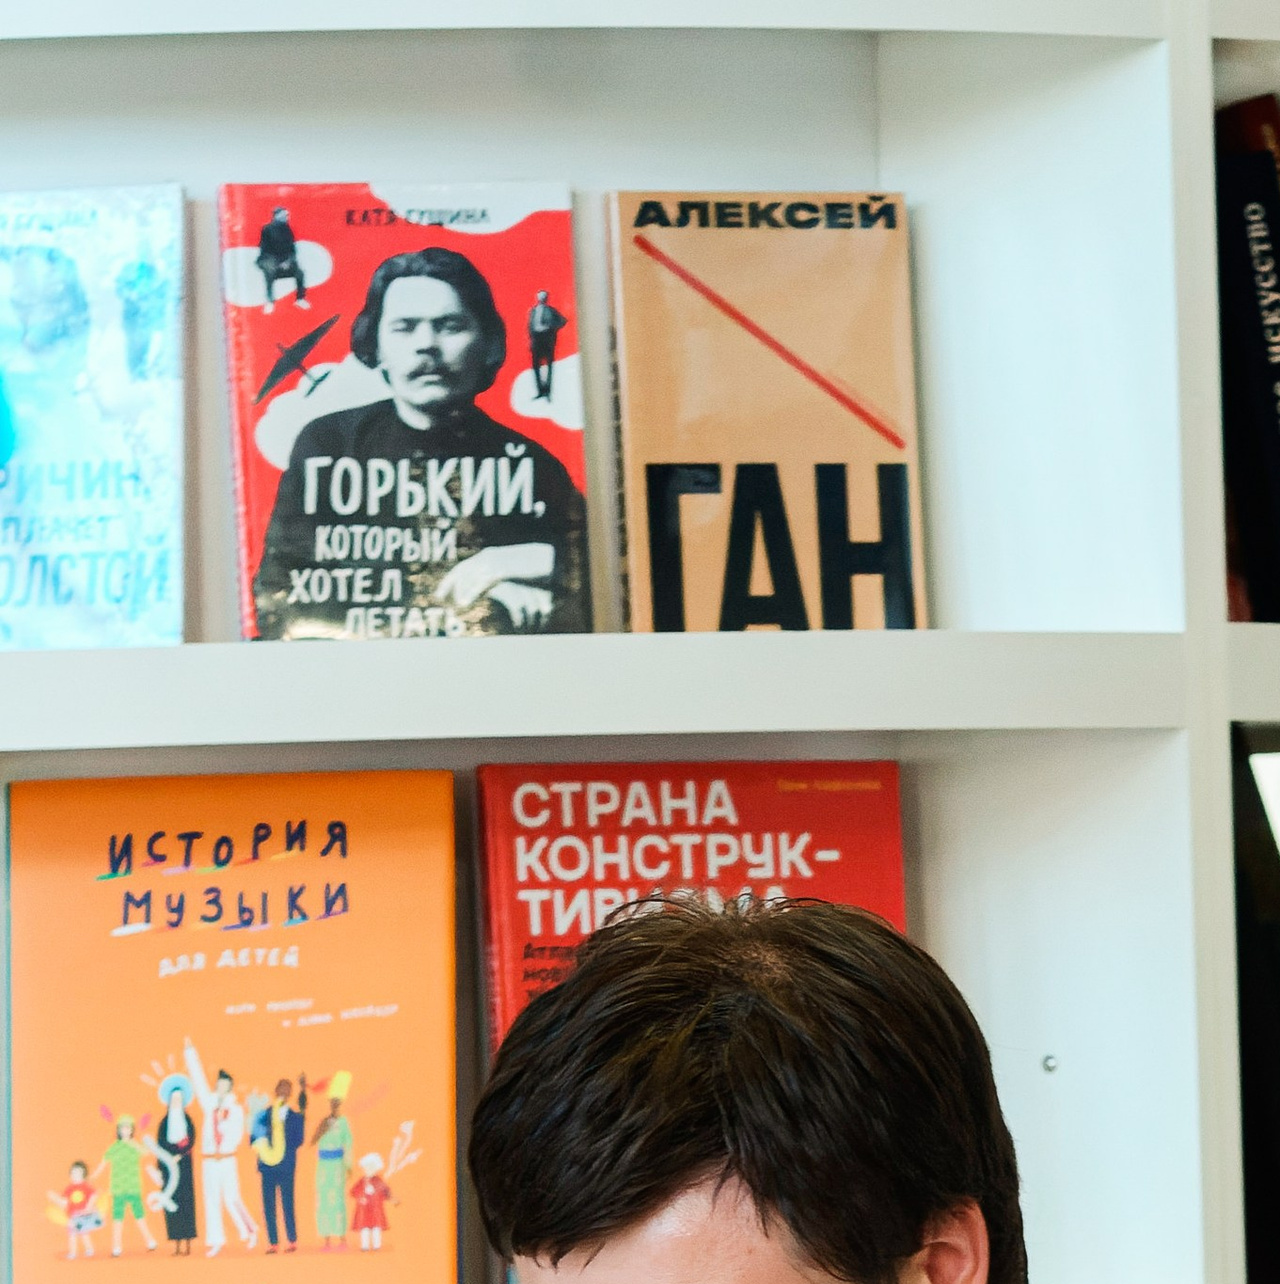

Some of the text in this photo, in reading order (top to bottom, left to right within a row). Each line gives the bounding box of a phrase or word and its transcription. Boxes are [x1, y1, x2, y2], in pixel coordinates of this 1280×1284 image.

[345, 207, 397, 226] КАТЯ
[633, 195, 898, 230] АЛЕКСЕЙ
[303, 441, 547, 519] ГОРЬКИЙ,
[314, 517, 458, 563] КОТОРЫЙ
[644, 463, 917, 631] ГАН
[286, 567, 402, 604] ХОТЕЛ
[344, 605, 467, 638] ЛЕТАТЬ
[510, 778, 741, 830] СТРАНА
[107, 819, 349, 876] ИСТОРИЯ
[514, 830, 842, 884] КОНСТРУК-
[120, 882, 351, 929] МУЗЫКИ
